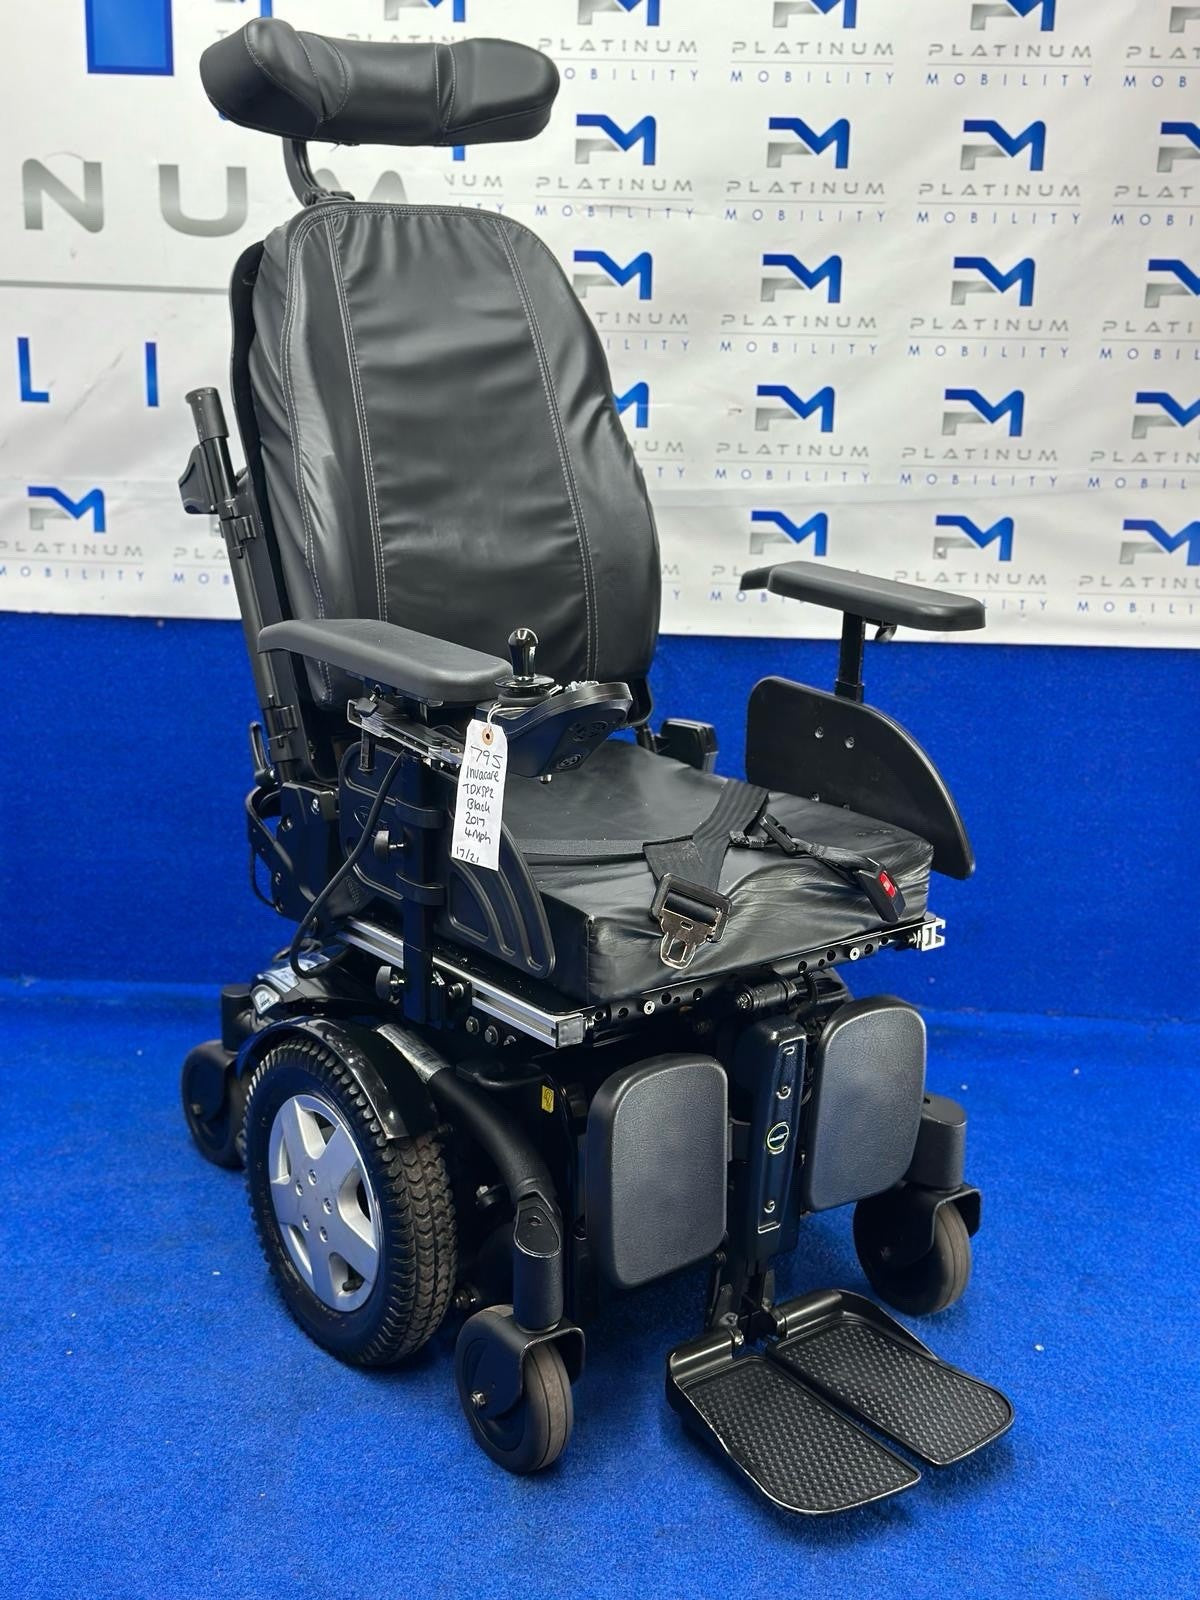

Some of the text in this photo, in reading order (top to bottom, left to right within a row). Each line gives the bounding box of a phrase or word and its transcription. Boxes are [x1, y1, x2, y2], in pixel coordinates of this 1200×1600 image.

[538, 38, 698, 54] PLATINUM
[732, 41, 893, 55] PLATINUM
[928, 44, 1092, 59] PLATINUM
[730, 70, 893, 84] MOBILITY
[926, 73, 1092, 88] MOBILITY
[536, 176, 693, 192] PLATINUM
[727, 180, 885, 196] PLATINUM
[919, 183, 1081, 198] PLATINUM
[535, 204, 694, 219] MOBILITY
[725, 208, 885, 223] MOBILITY
[916, 211, 1081, 225] MOBILITY
[721, 314, 877, 329] PLATINUM
[910, 317, 1069, 332] PLATINUM
[719, 341, 878, 355] MOBILITY
[907, 344, 1069, 359] MOBILITY
[716, 442, 870, 457] PLATINUM
[902, 446, 1059, 462] PLATINUM
[714, 468, 871, 483] MOBILITY
[900, 473, 1058, 487] MOBILITY
[894, 570, 1047, 585] PLATINUM
[471, 745, 503, 769] 795
[465, 811, 485, 827] 2017
